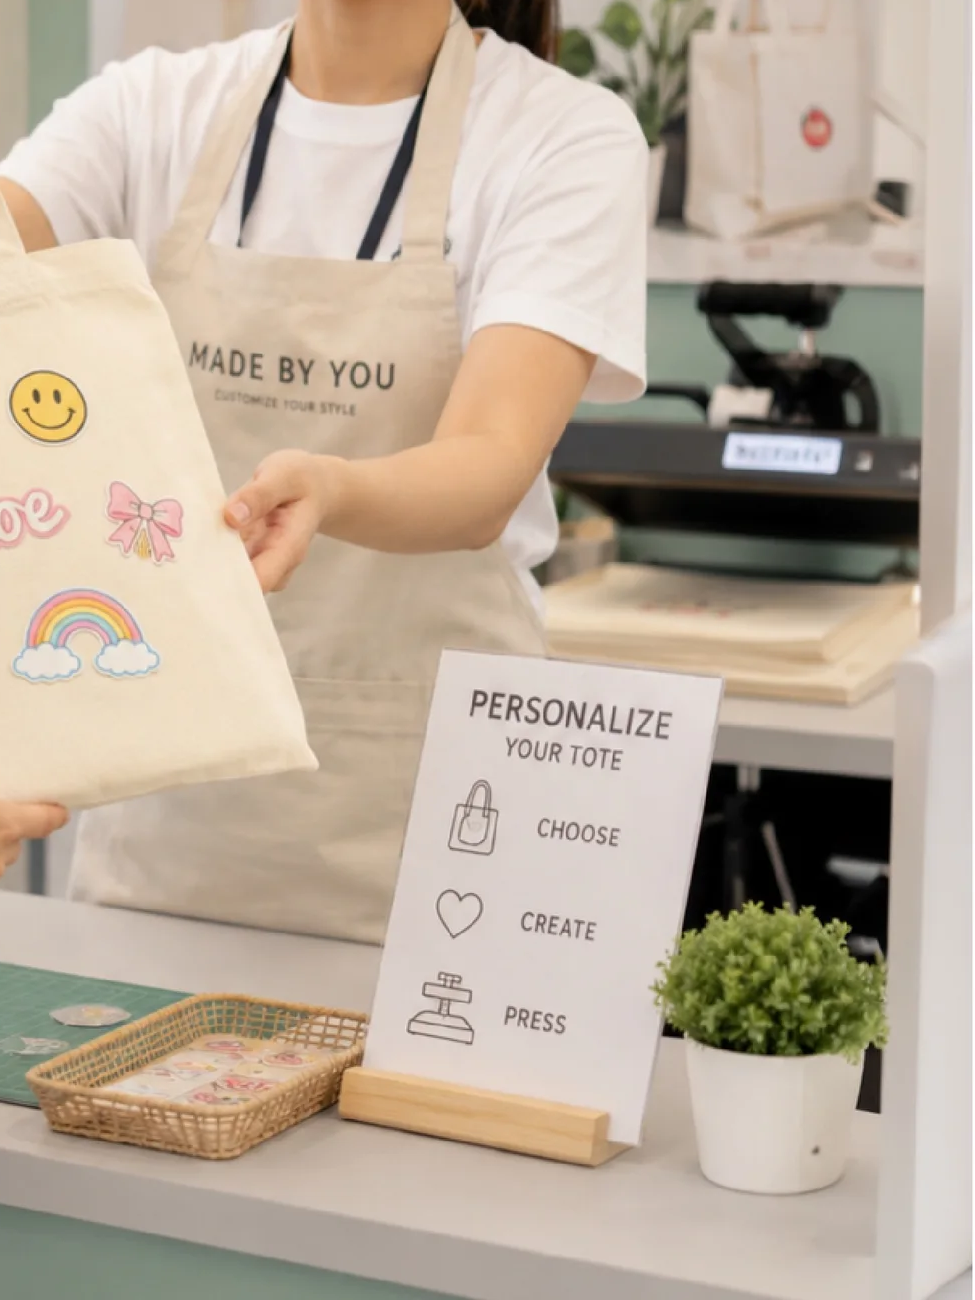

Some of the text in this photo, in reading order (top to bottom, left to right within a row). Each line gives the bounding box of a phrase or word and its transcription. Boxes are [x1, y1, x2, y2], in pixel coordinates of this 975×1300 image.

[188, 341, 396, 391] MADE BY YOU
[214, 388, 358, 417] CUSTOMIZE YOUR STYLE
[469, 688, 674, 741] PERSONALIZE
[504, 736, 625, 772] YOUR TOTE
[536, 817, 621, 848] CHOOSE
[519, 910, 598, 942] CREATE
[503, 1004, 568, 1035] PRESS
